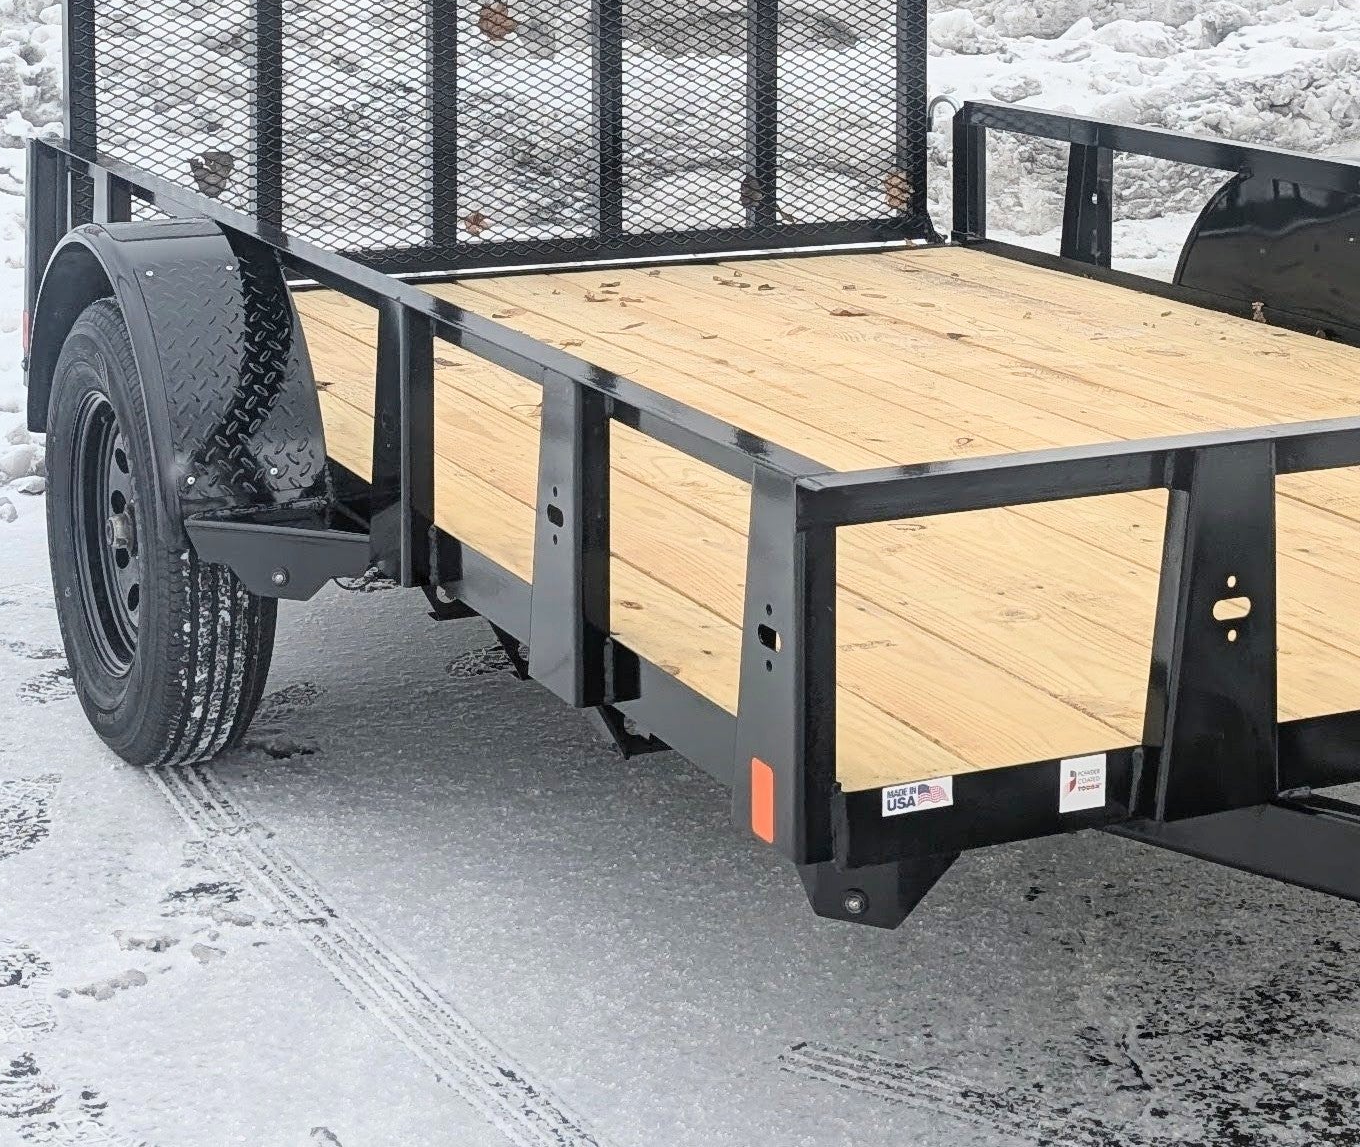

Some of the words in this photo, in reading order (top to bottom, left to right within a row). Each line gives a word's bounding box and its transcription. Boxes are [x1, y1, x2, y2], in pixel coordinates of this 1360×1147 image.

[887, 787, 908, 798] MADE
[909, 786, 917, 794] IN
[887, 796, 916, 811] USA
